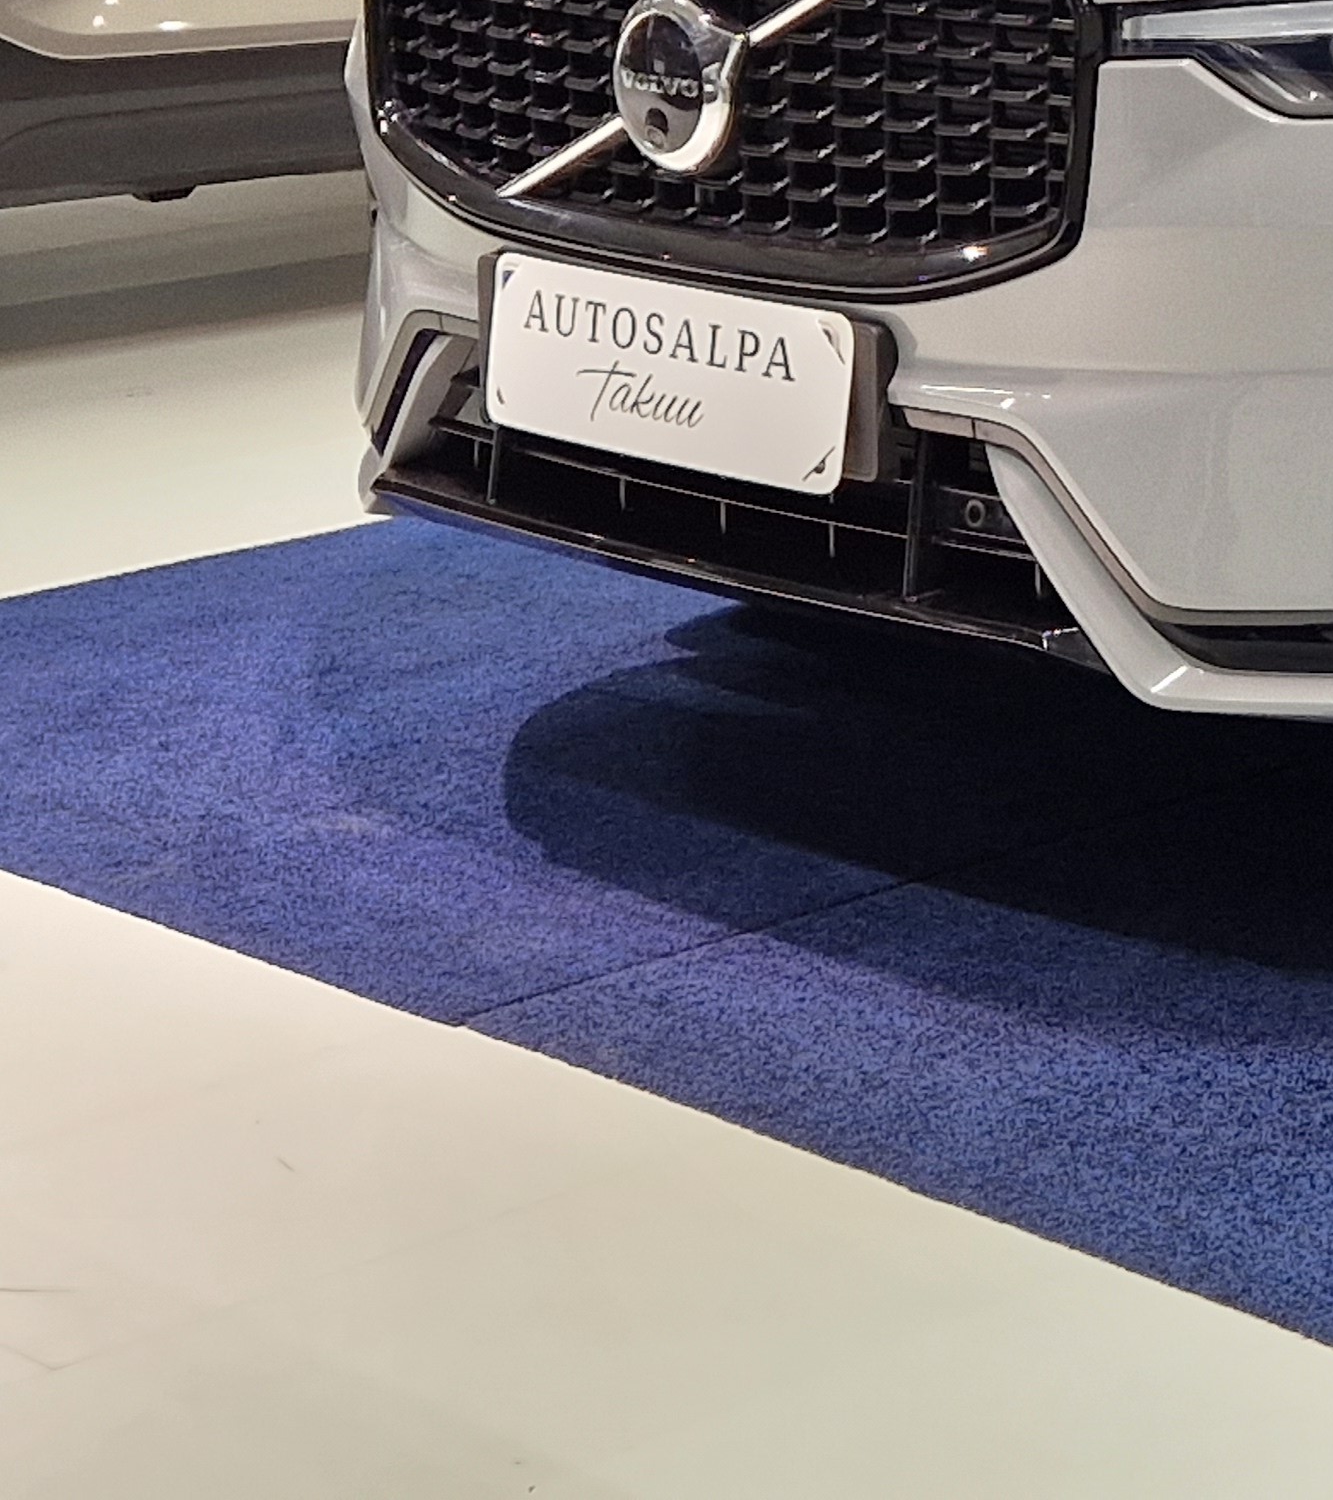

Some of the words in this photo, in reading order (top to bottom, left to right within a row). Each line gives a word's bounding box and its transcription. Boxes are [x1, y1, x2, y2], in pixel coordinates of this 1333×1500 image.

[620, 68, 699, 98] VOLVO
[524, 289, 796, 382] AUTOSALPA
[576, 361, 704, 428] Takuu
